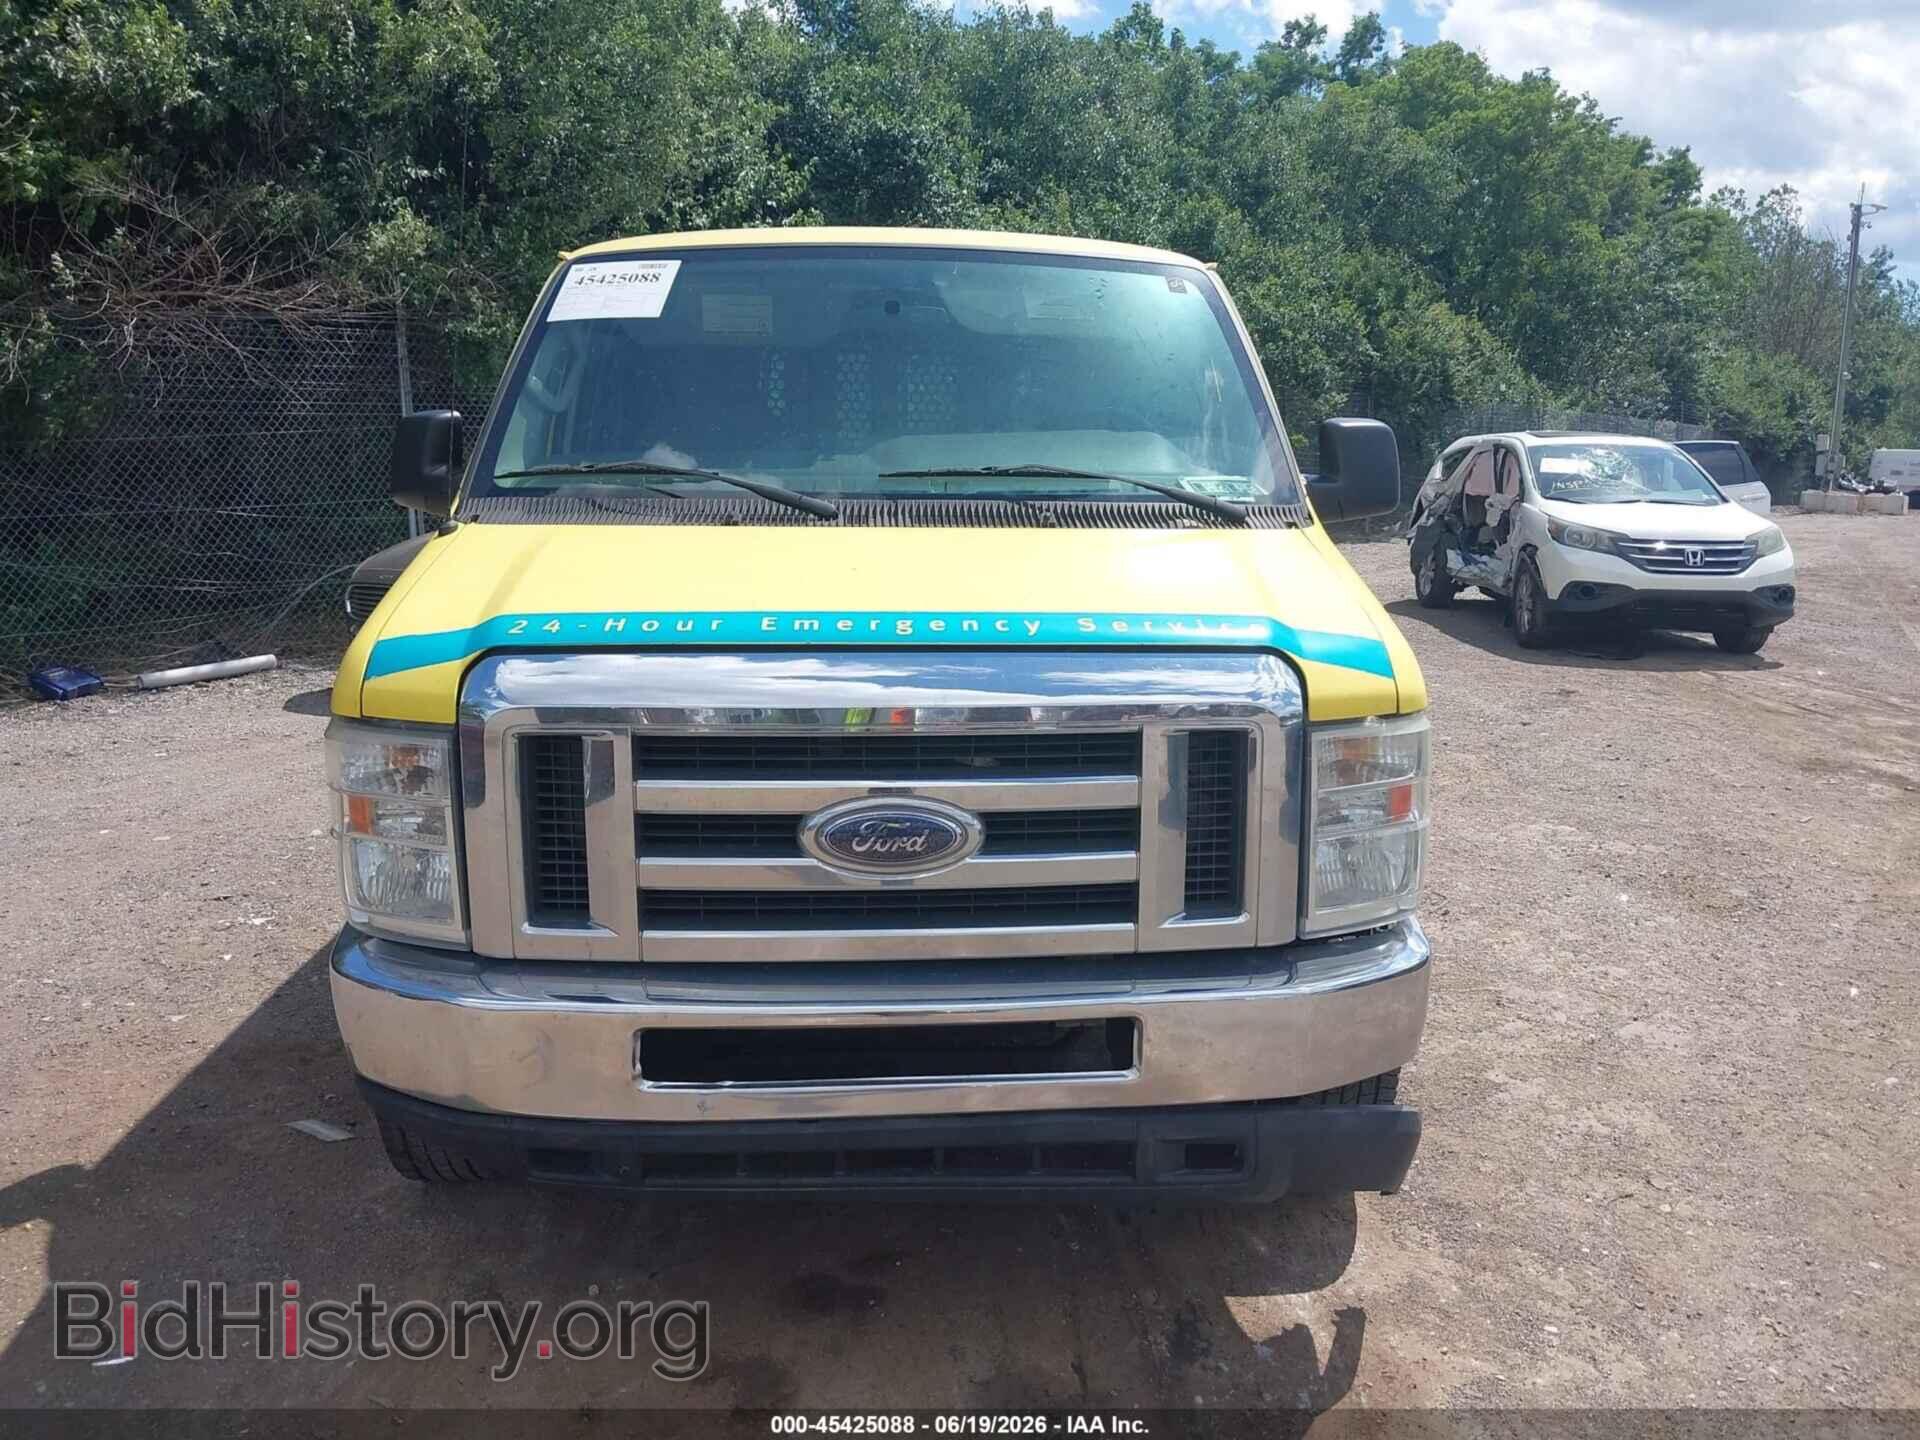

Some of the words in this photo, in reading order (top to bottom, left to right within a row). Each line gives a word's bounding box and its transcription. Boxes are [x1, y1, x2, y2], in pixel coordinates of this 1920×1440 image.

[574, 272, 662, 286] 45425088
[506, 616, 725, 634] 24-Hour
[760, 616, 1041, 635] Emergency
[852, 820, 929, 852] Ford
